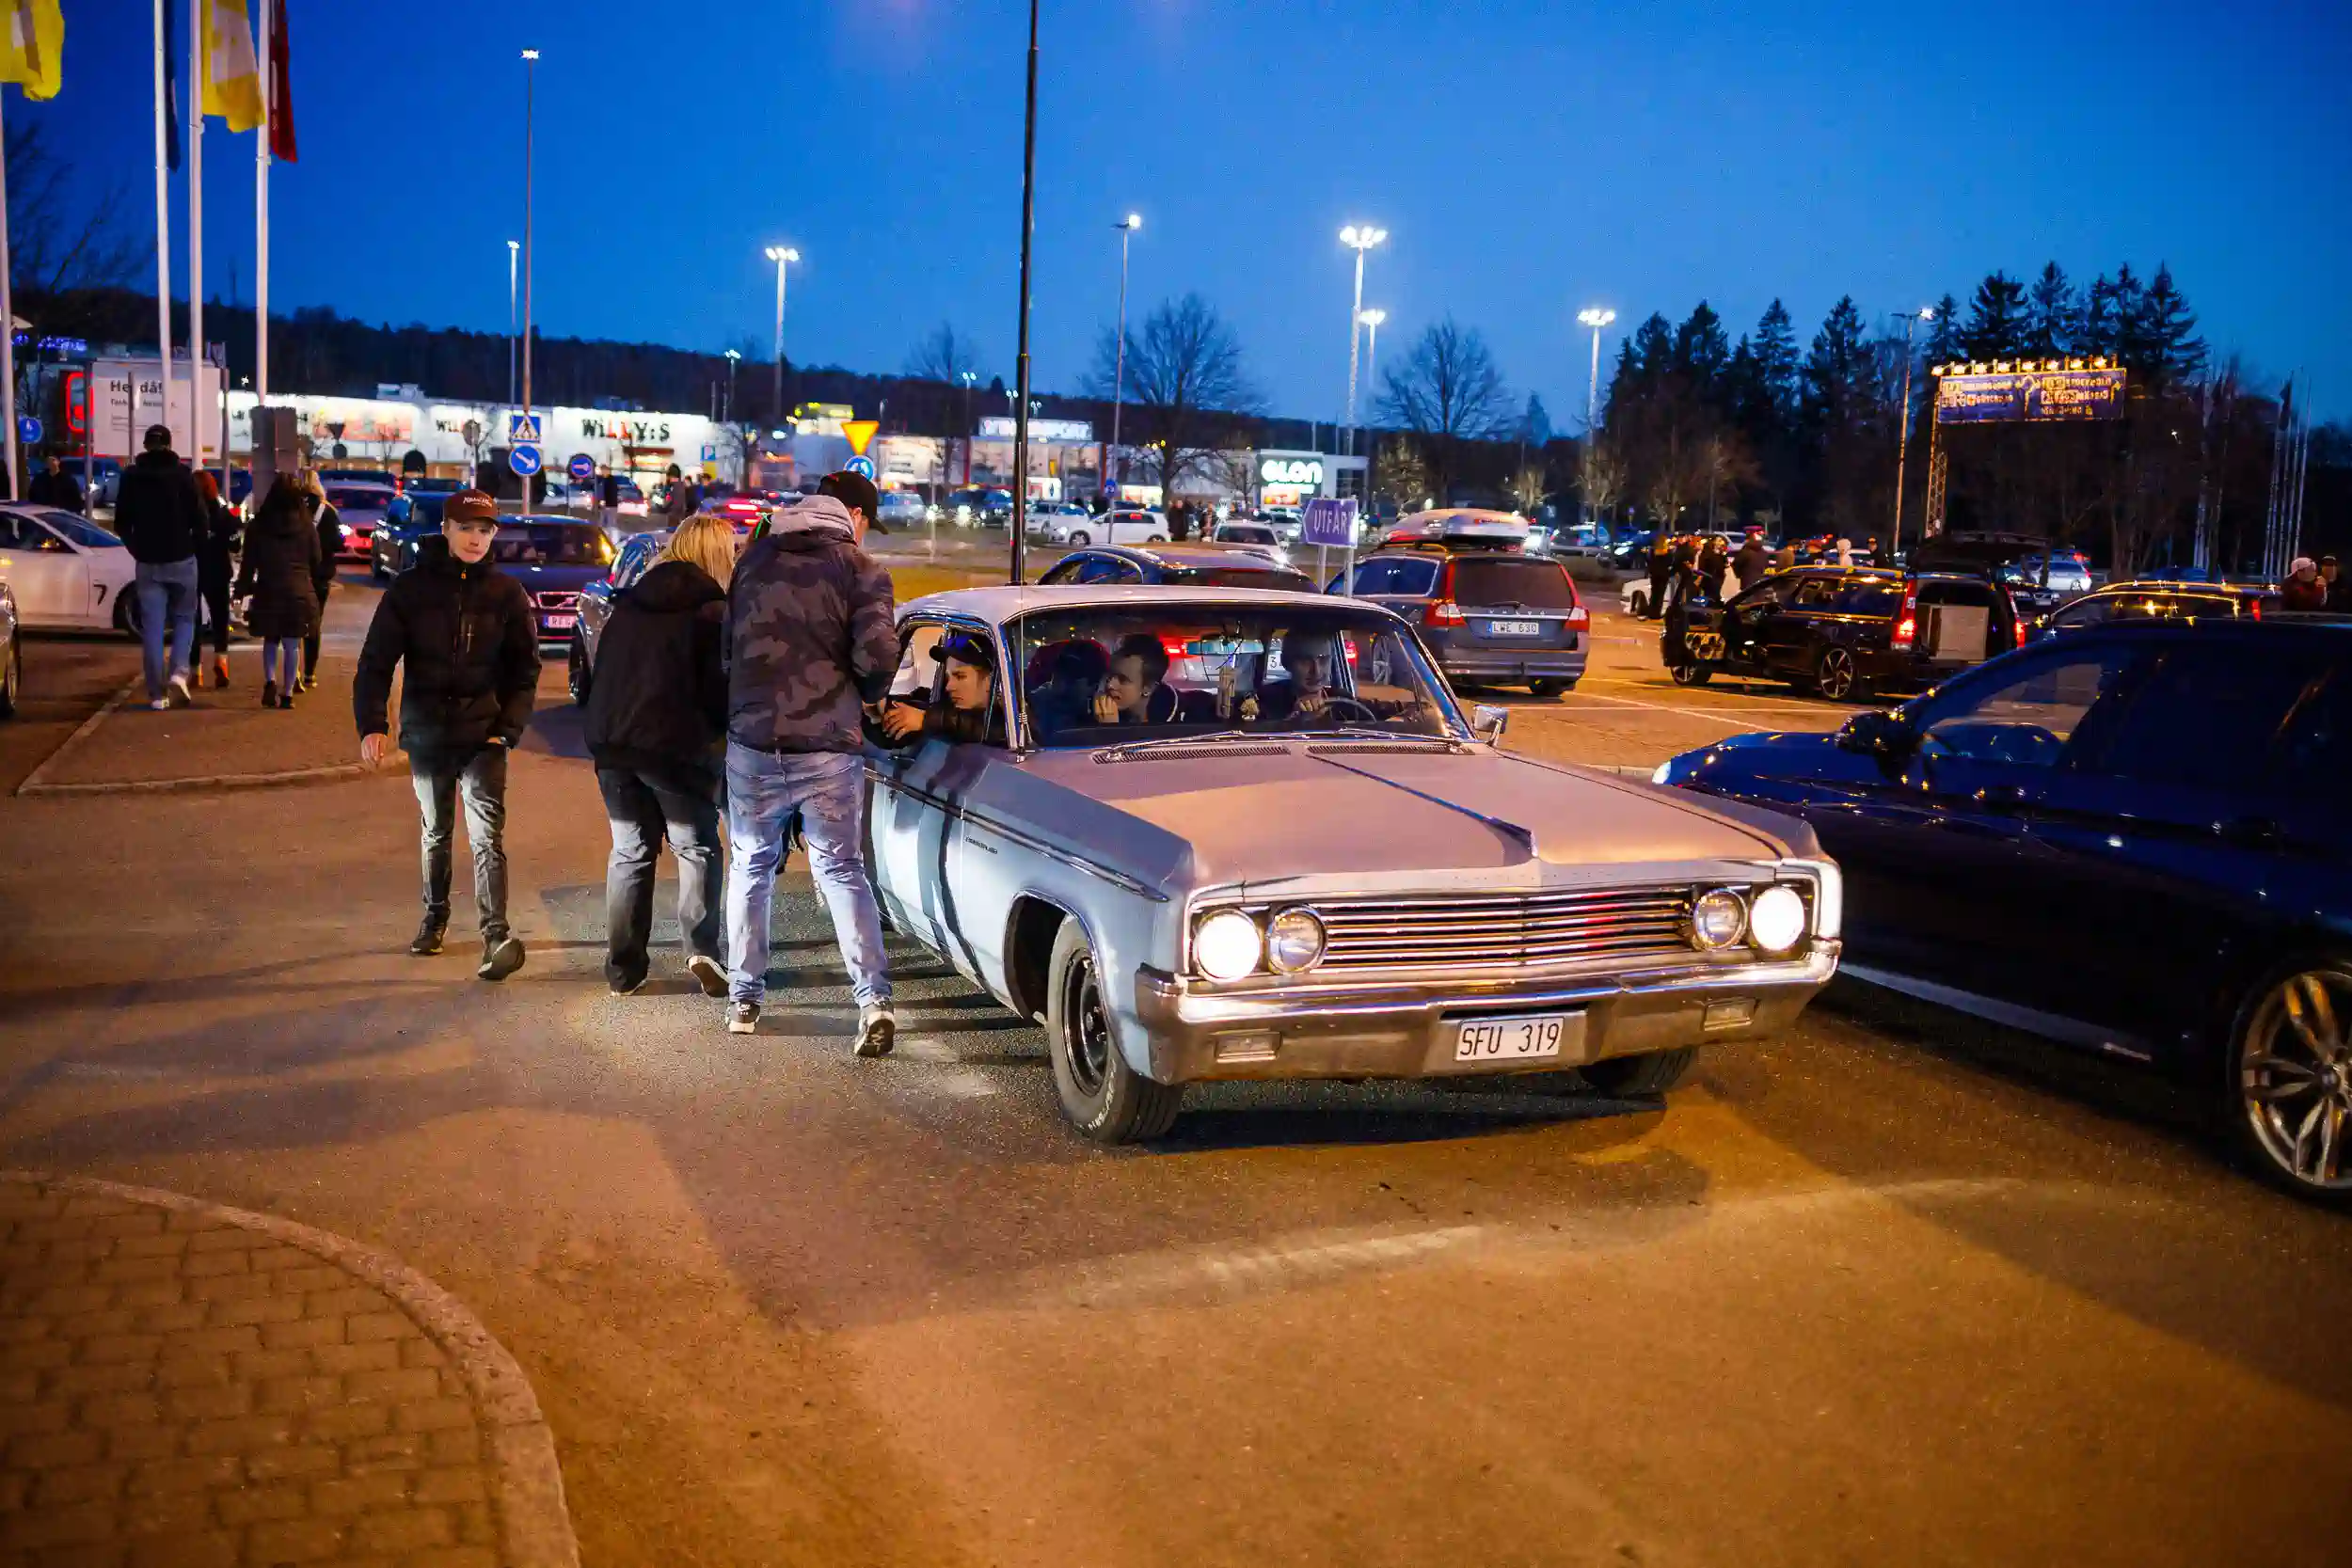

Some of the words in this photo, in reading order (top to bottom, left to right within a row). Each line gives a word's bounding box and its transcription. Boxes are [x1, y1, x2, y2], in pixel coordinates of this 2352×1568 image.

[93, 583, 107, 606] 7
[1459, 1025, 1503, 1055] SFU
[1518, 1023, 1560, 1053] 319
